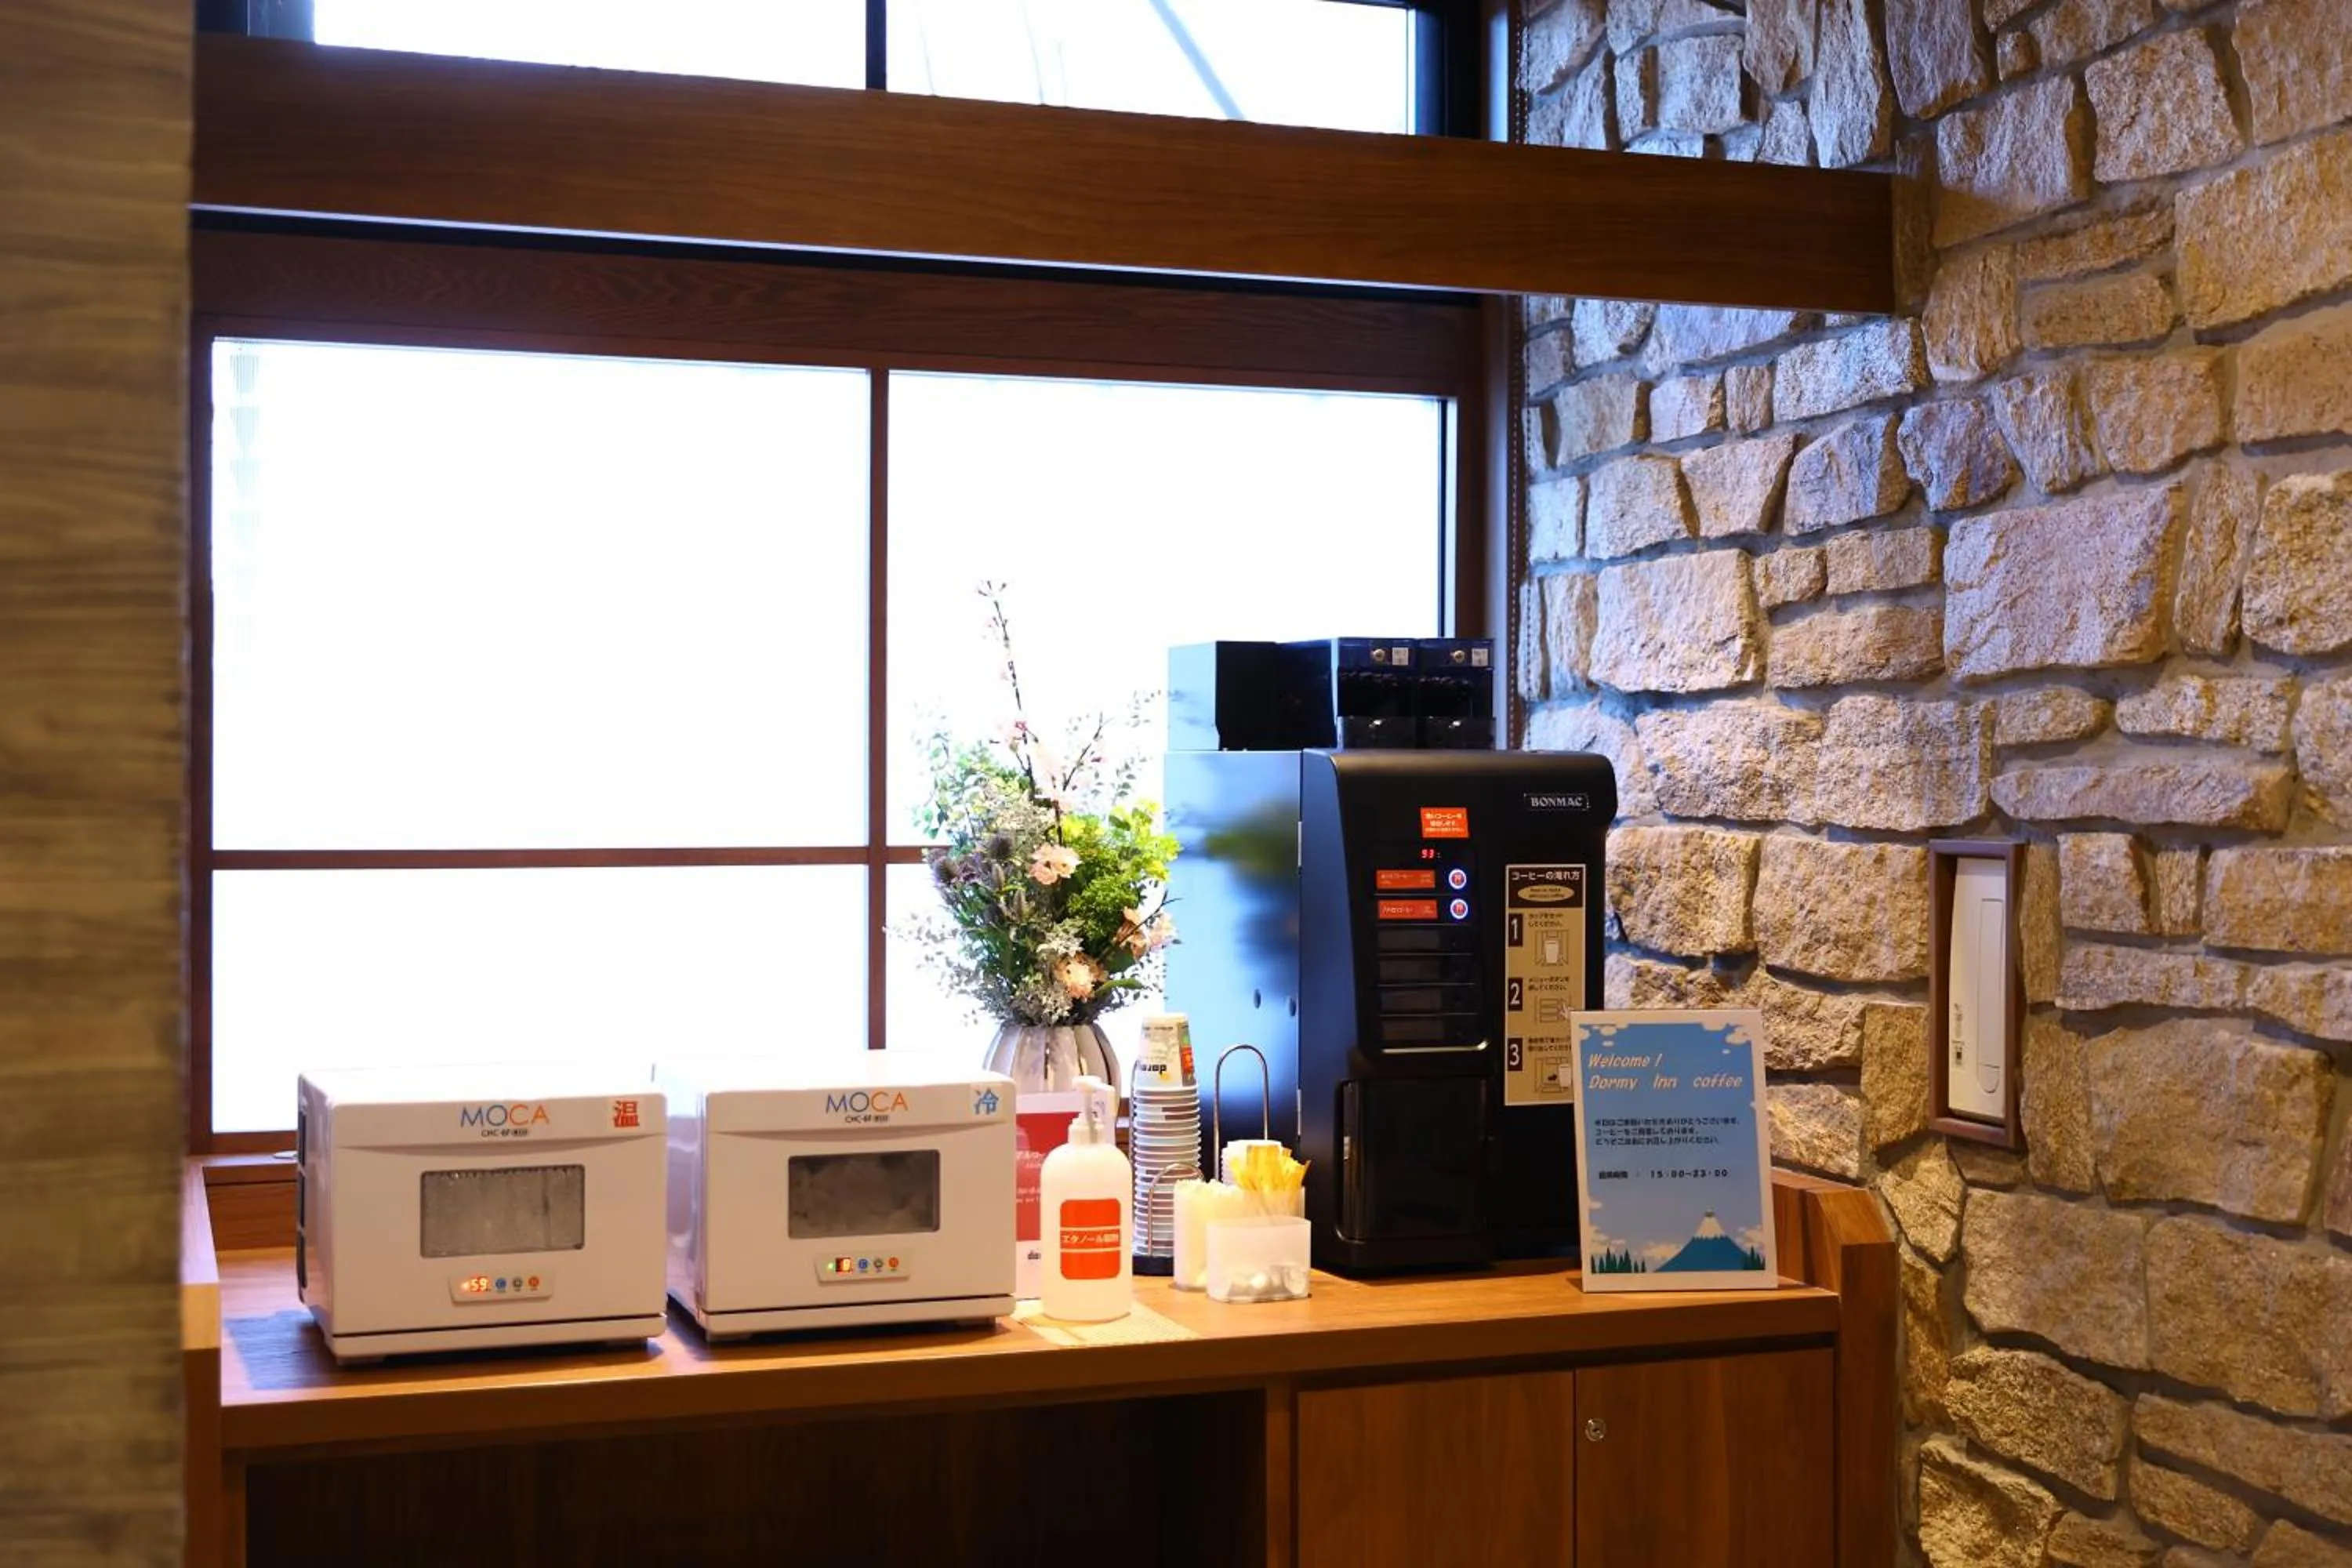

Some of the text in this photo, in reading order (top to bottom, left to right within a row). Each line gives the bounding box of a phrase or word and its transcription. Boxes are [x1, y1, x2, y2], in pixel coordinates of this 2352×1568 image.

[1530, 797, 1583, 807] BONMAC
[1510, 918, 1519, 940] 1
[1509, 982, 1520, 1006] 2
[1509, 1043, 1520, 1066] 3
[1588, 1074, 1639, 1090] Dormy
[1692, 1073, 1744, 1088] coffee
[826, 1091, 909, 1113] MOCA
[973, 1087, 1000, 1115] 冷
[460, 1104, 550, 1127] MOCA
[613, 1100, 640, 1127] 温
